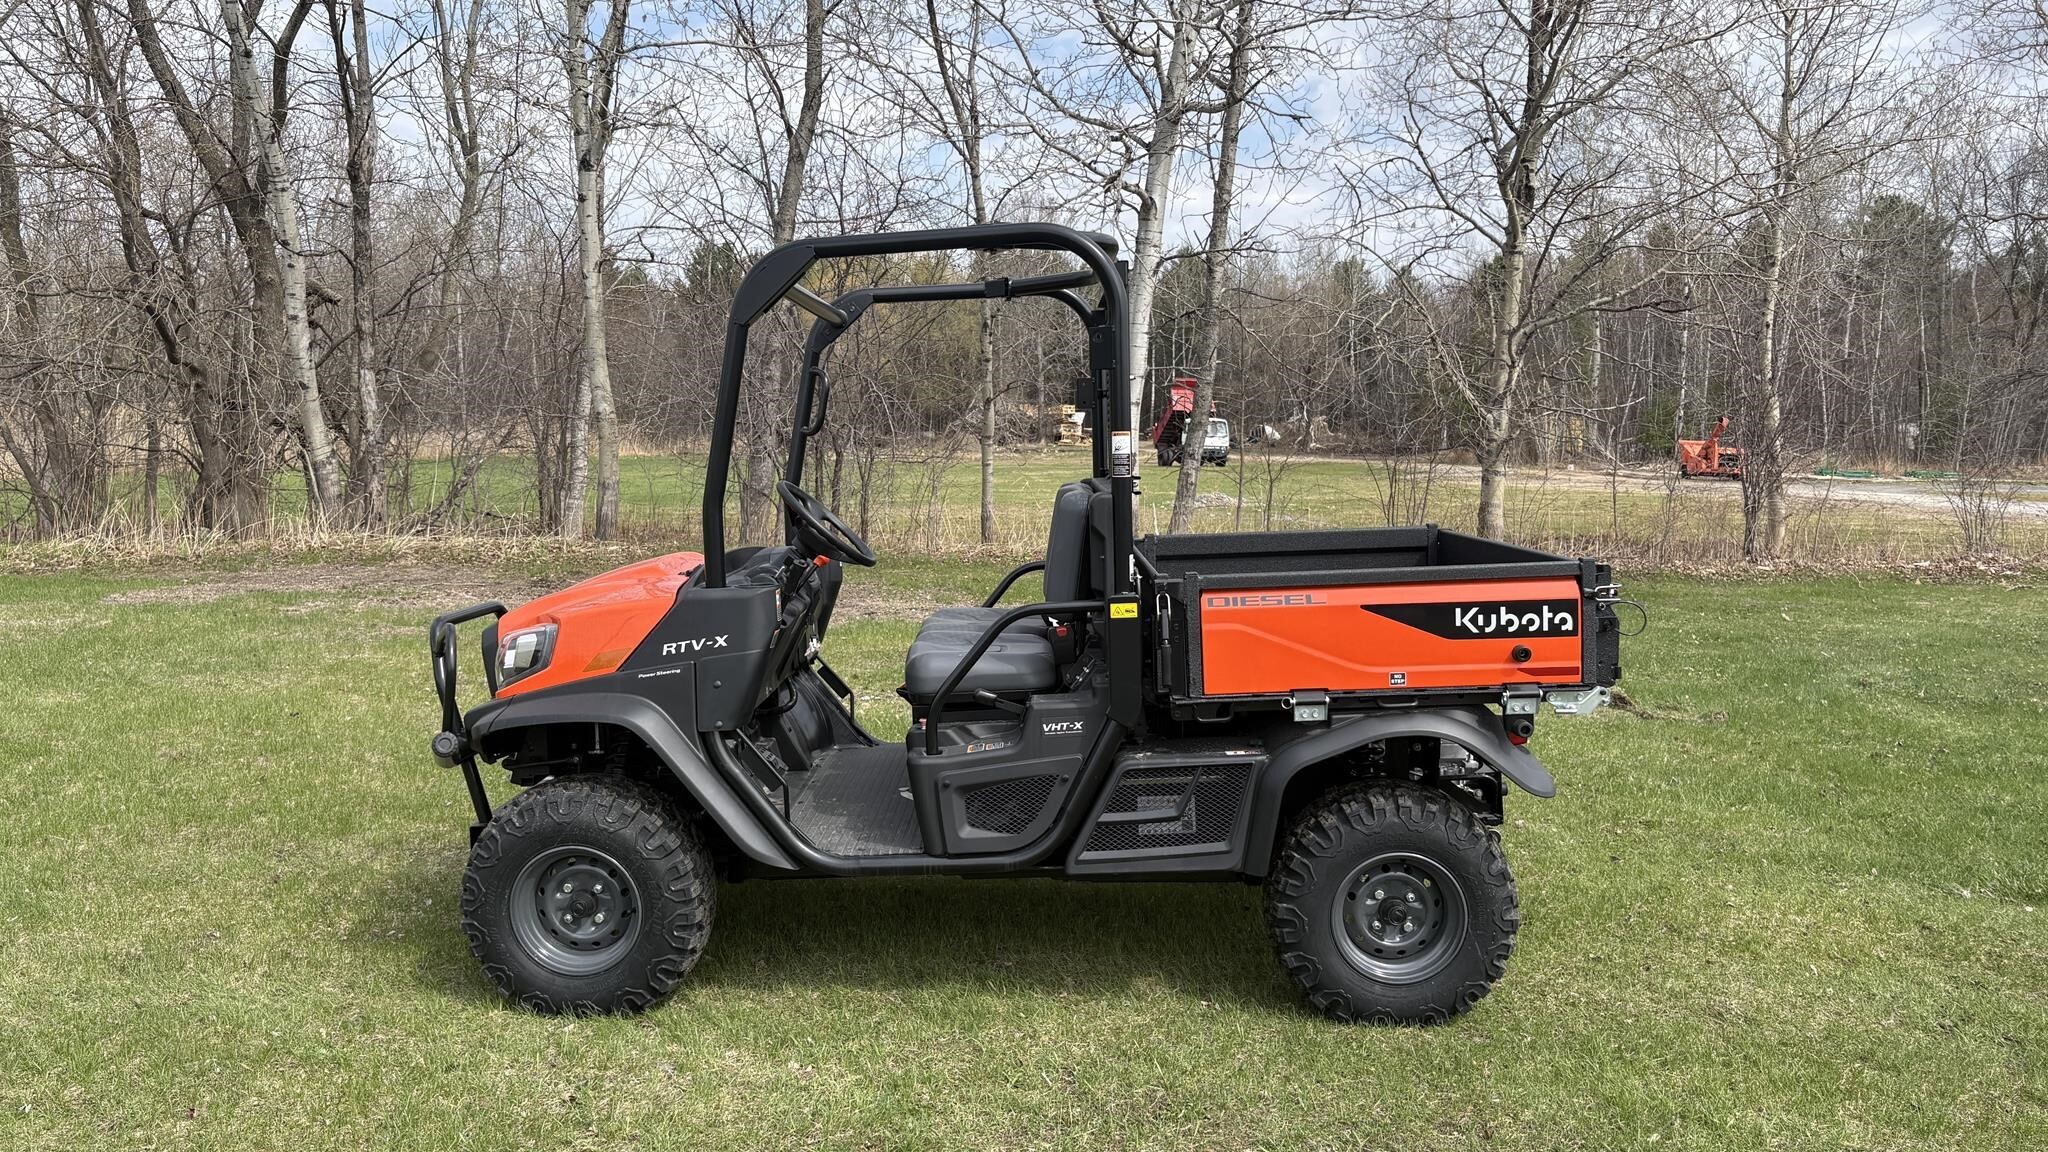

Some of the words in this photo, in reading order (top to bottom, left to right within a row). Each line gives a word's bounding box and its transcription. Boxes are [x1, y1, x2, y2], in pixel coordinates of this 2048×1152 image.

[1207, 595, 1326, 608] DIESEL
[1455, 605, 1573, 633] Kubota
[663, 635, 728, 655] RTV-X
[1042, 721, 1084, 731] VHT-X
